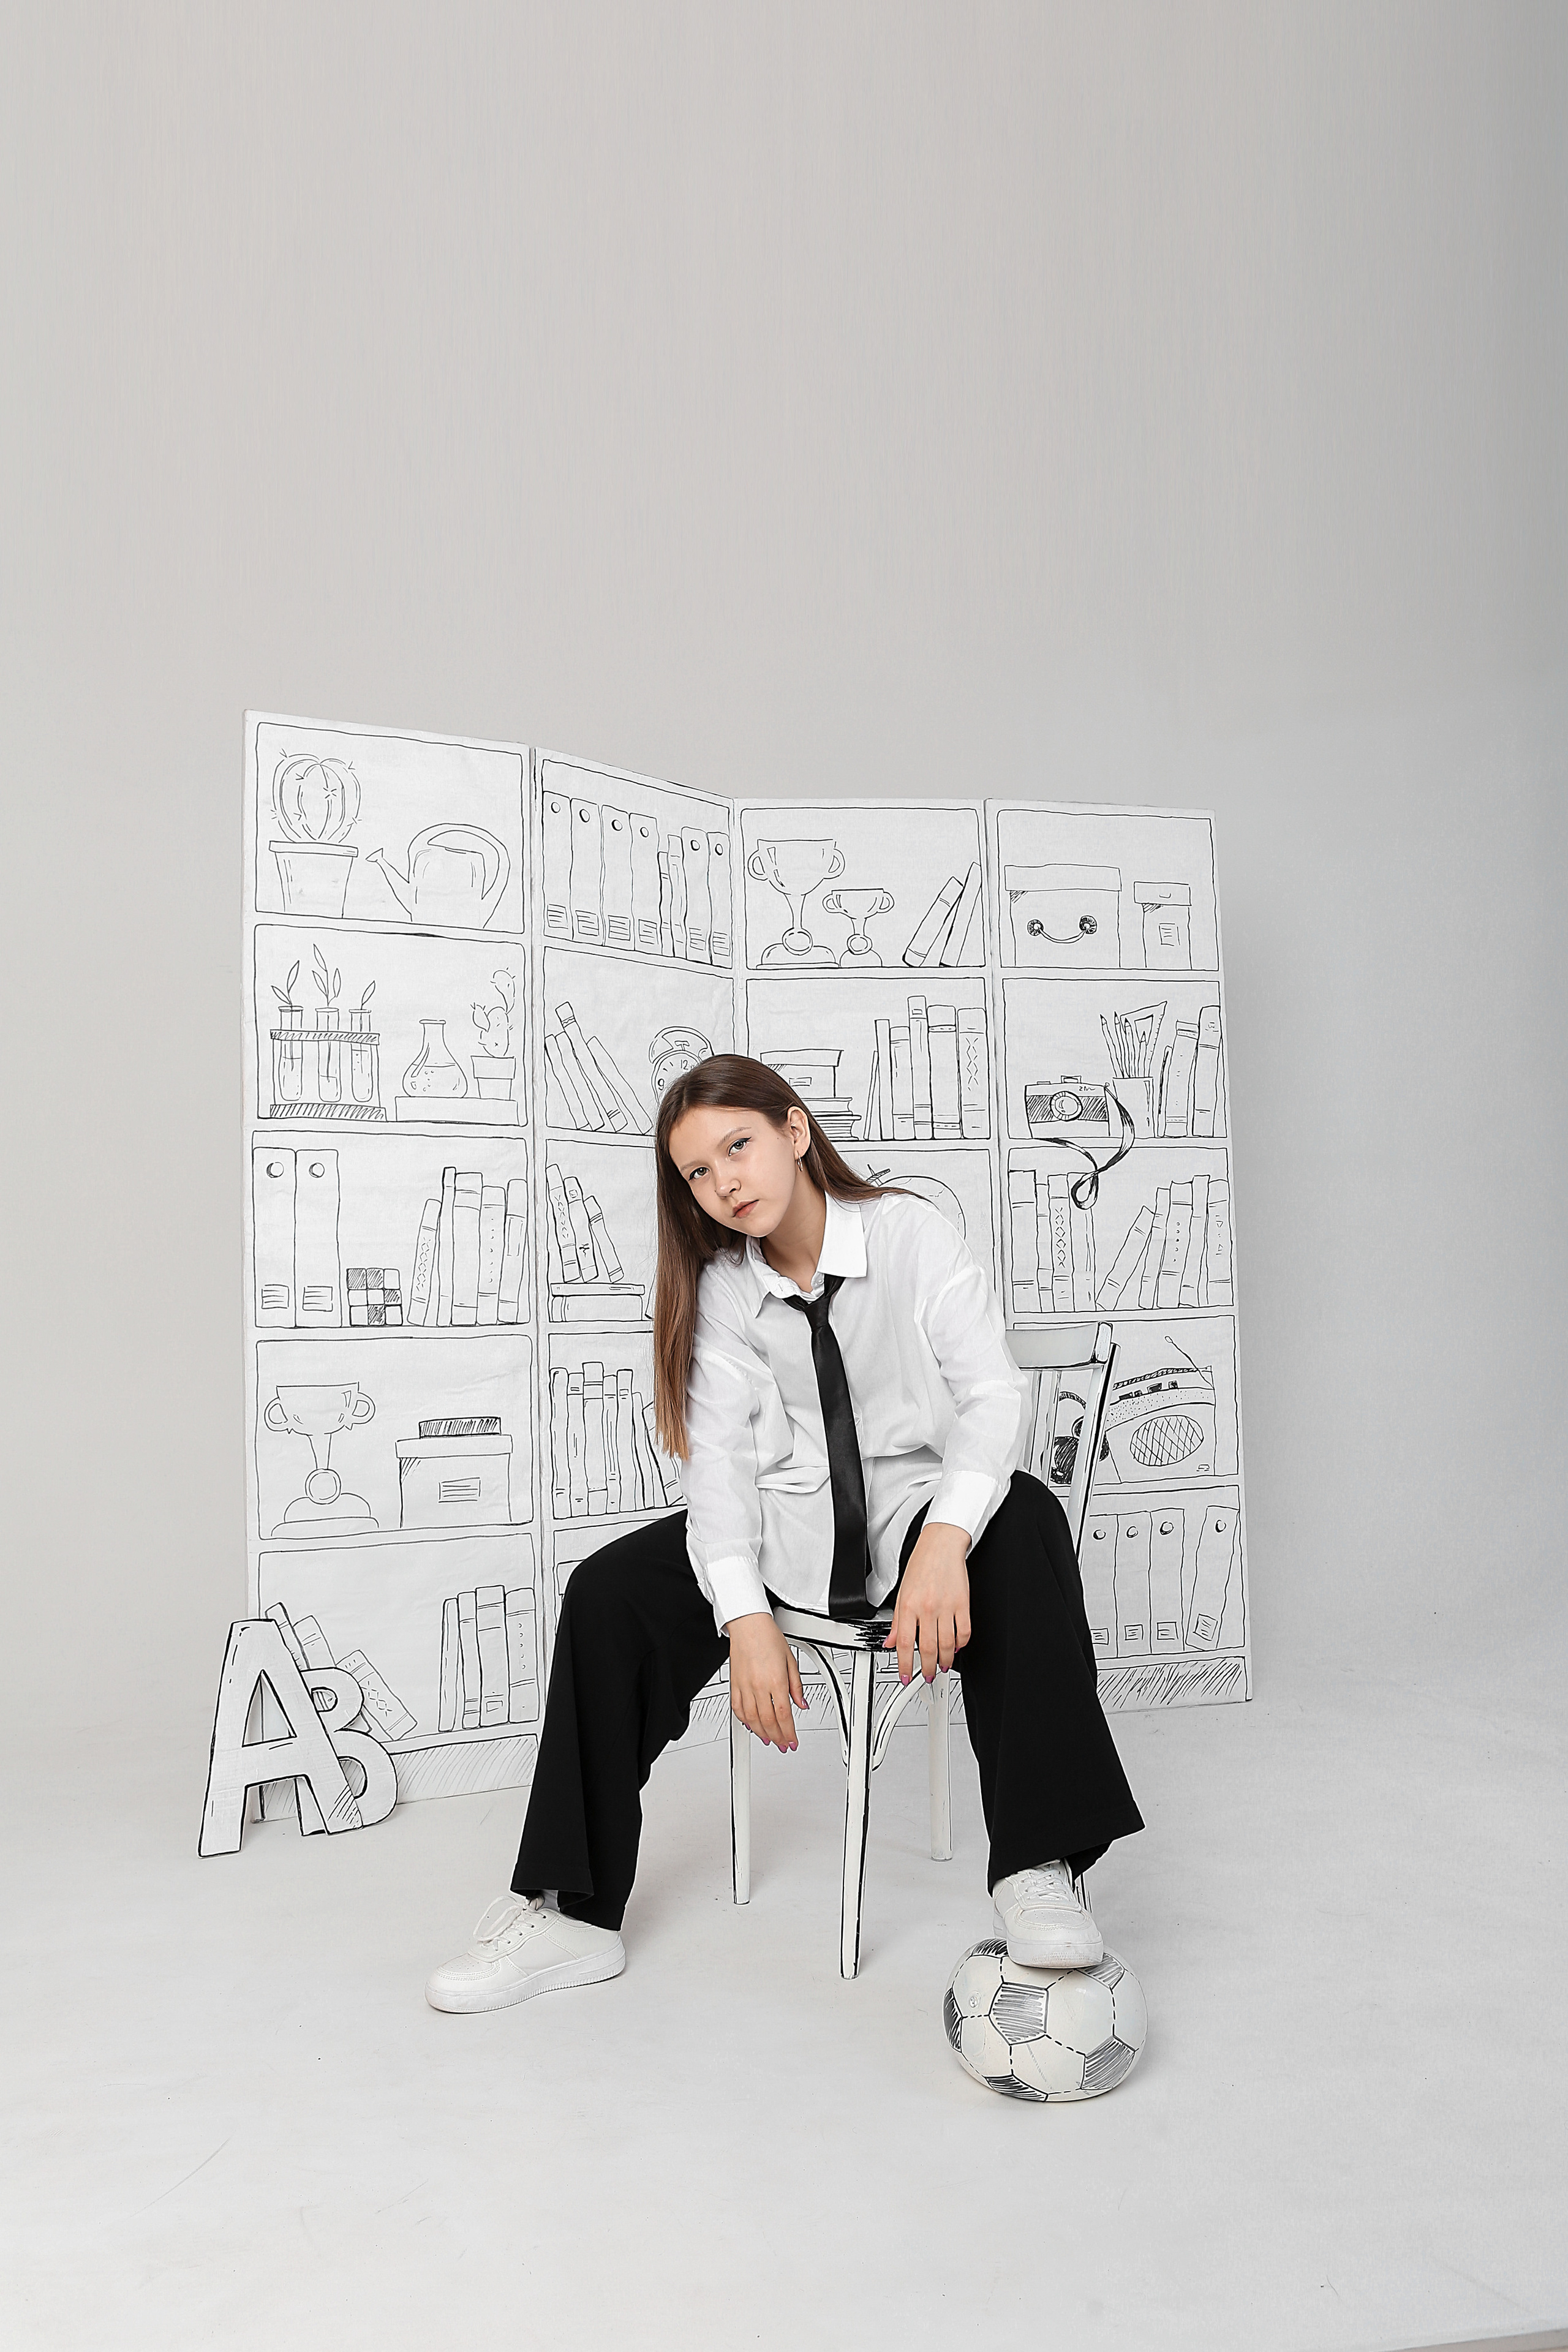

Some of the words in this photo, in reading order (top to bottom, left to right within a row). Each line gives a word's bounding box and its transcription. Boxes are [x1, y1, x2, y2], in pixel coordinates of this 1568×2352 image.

[680, 1059, 688, 1070] 12
[657, 1078, 665, 1091] 9
[198, 1618, 398, 1858] AB
